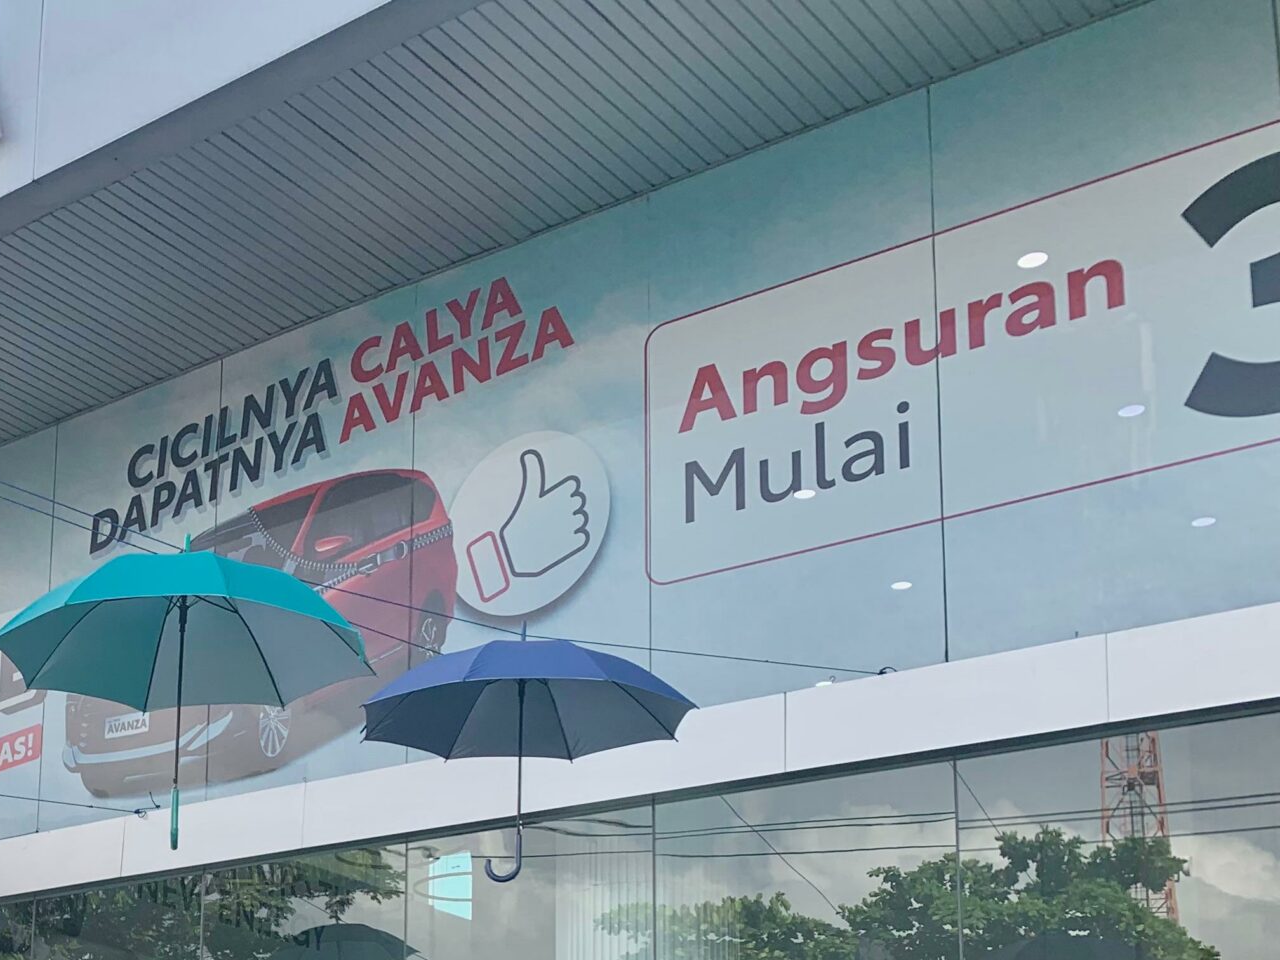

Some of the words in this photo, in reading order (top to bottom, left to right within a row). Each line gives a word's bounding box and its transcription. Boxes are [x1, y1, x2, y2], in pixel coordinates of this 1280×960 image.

[89, 416, 326, 554] DAPATNYA
[339, 306, 575, 443] AVANZA
[127, 358, 338, 489] CICILNYA
[351, 276, 523, 383] CALYA
[678, 259, 1125, 433] Angsuran
[684, 401, 911, 523] Mulai
[107, 719, 148, 735] AVANZA
